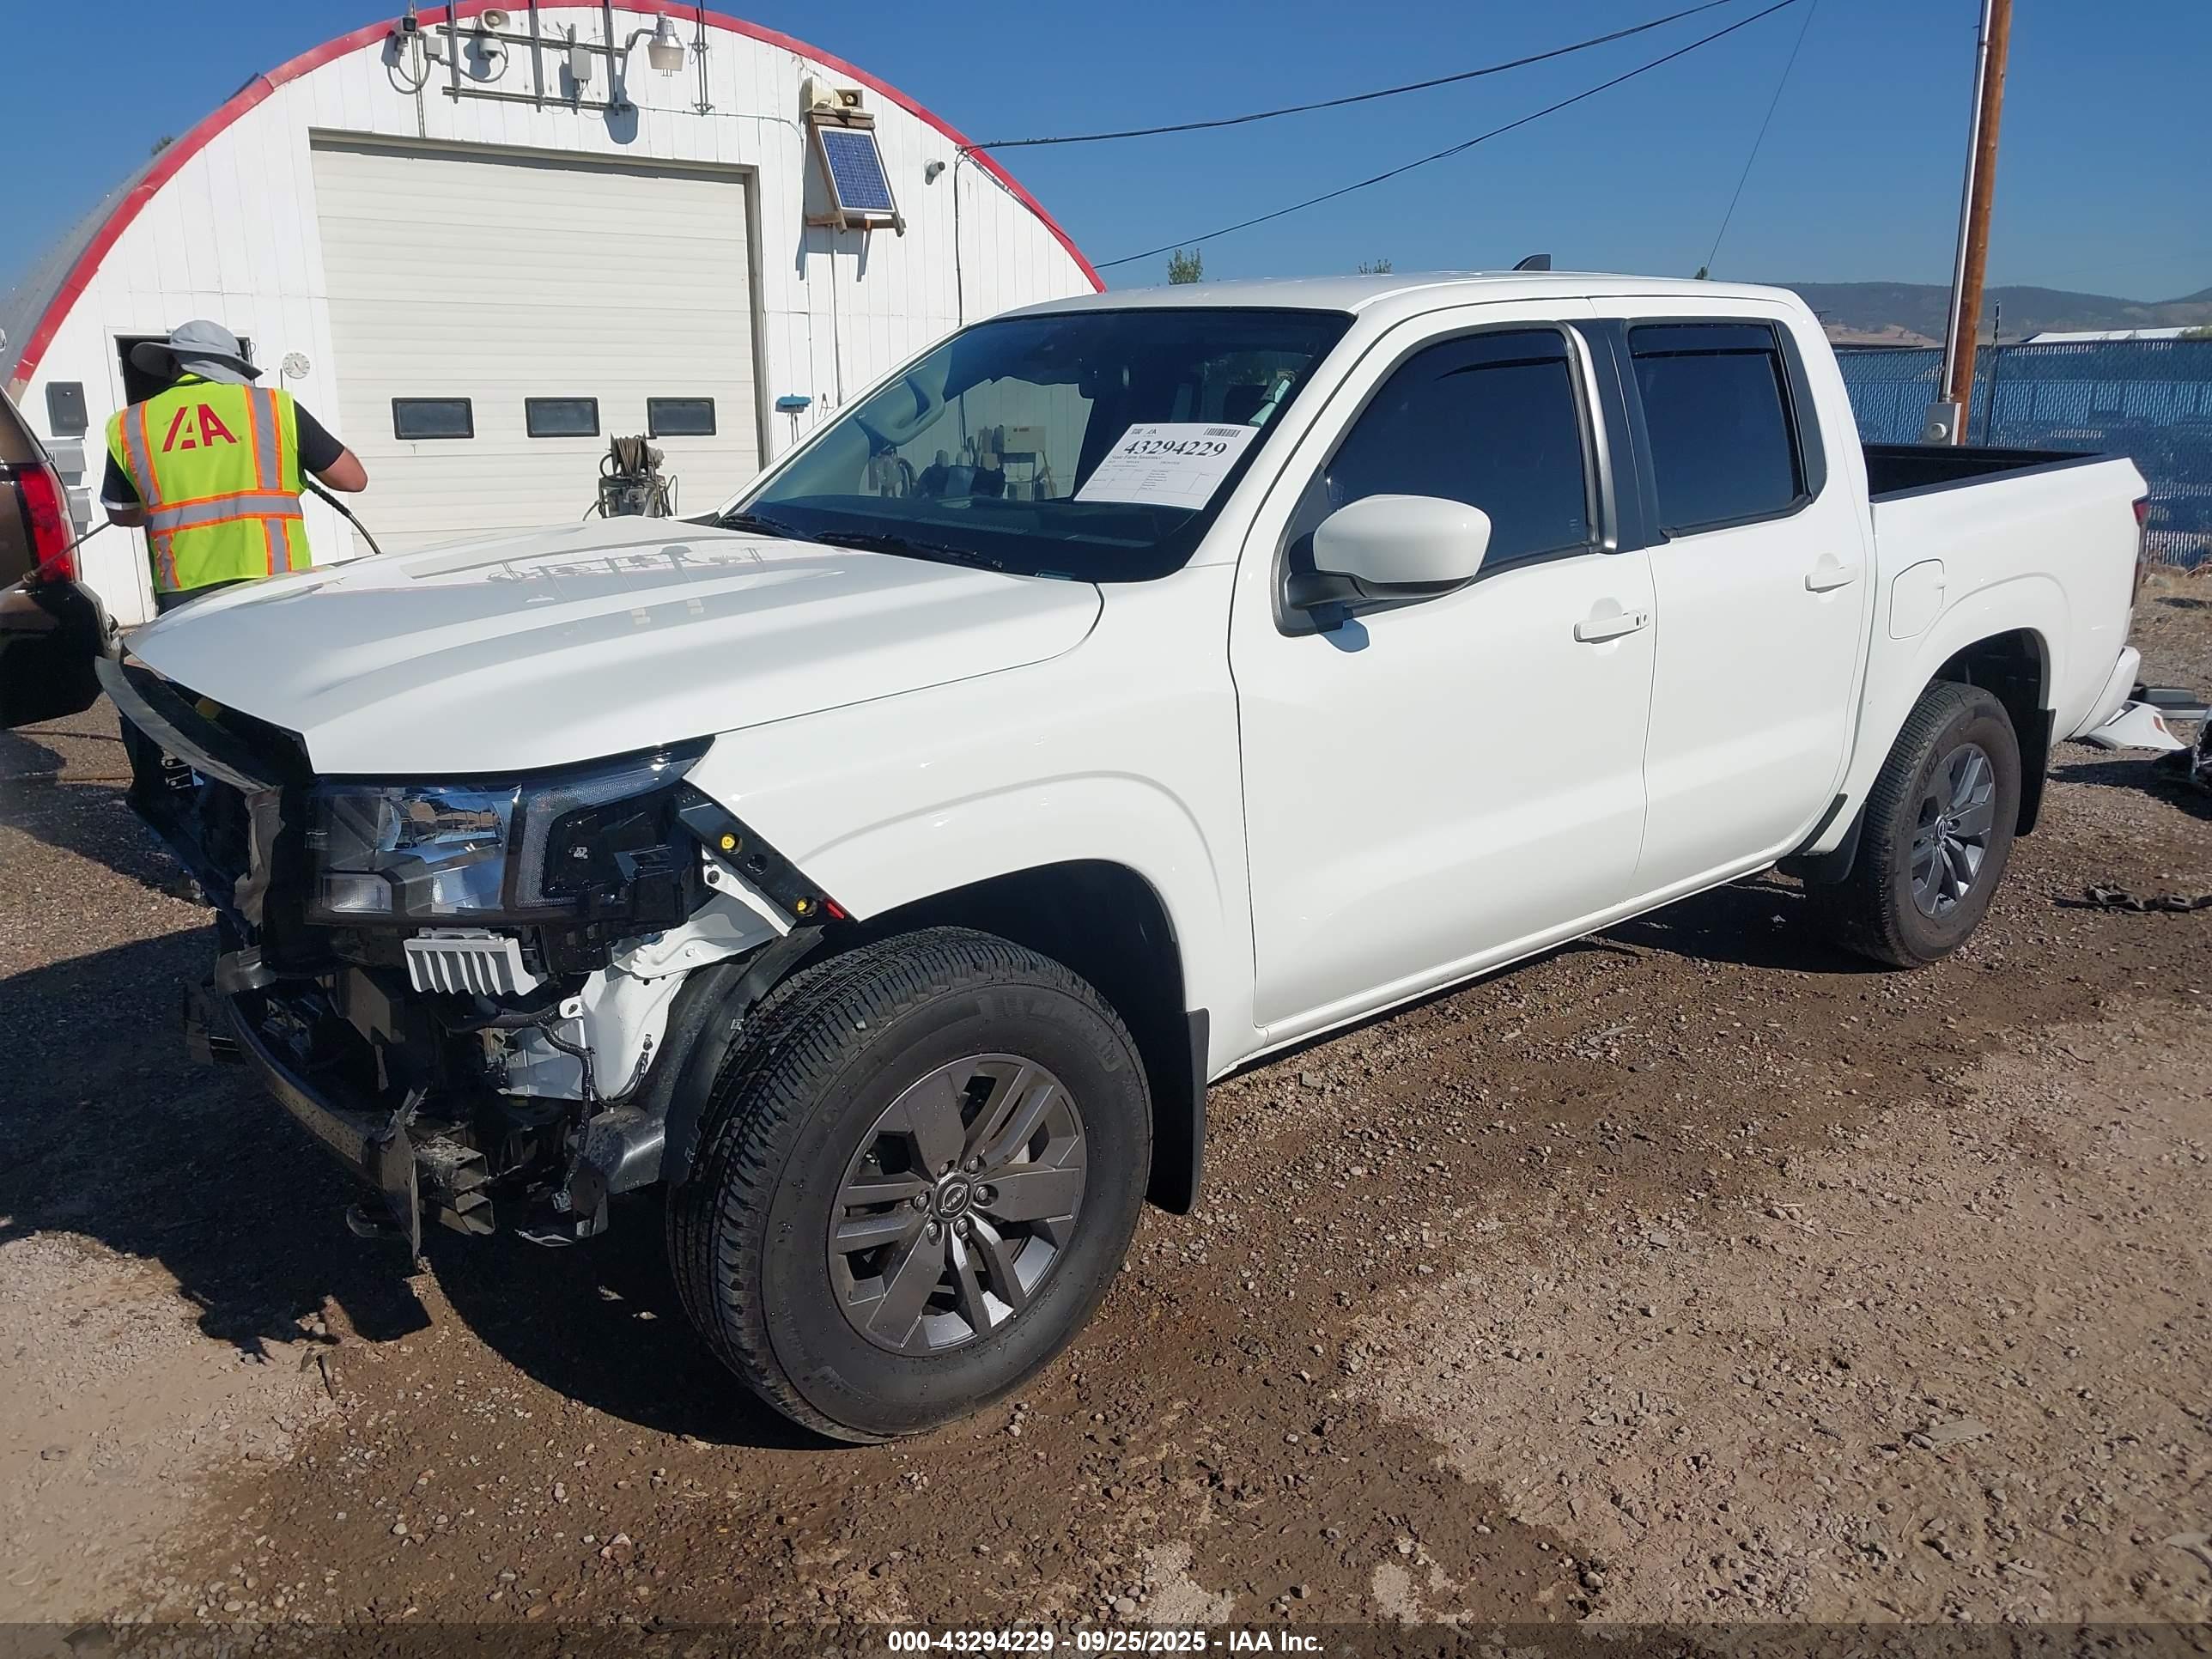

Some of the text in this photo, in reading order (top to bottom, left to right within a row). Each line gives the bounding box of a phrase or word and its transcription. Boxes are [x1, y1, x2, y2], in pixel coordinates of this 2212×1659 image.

[162, 404, 236, 452] IAA
[1124, 440, 1227, 457] 43294229
[940, 1183, 968, 1213] NISSAN
